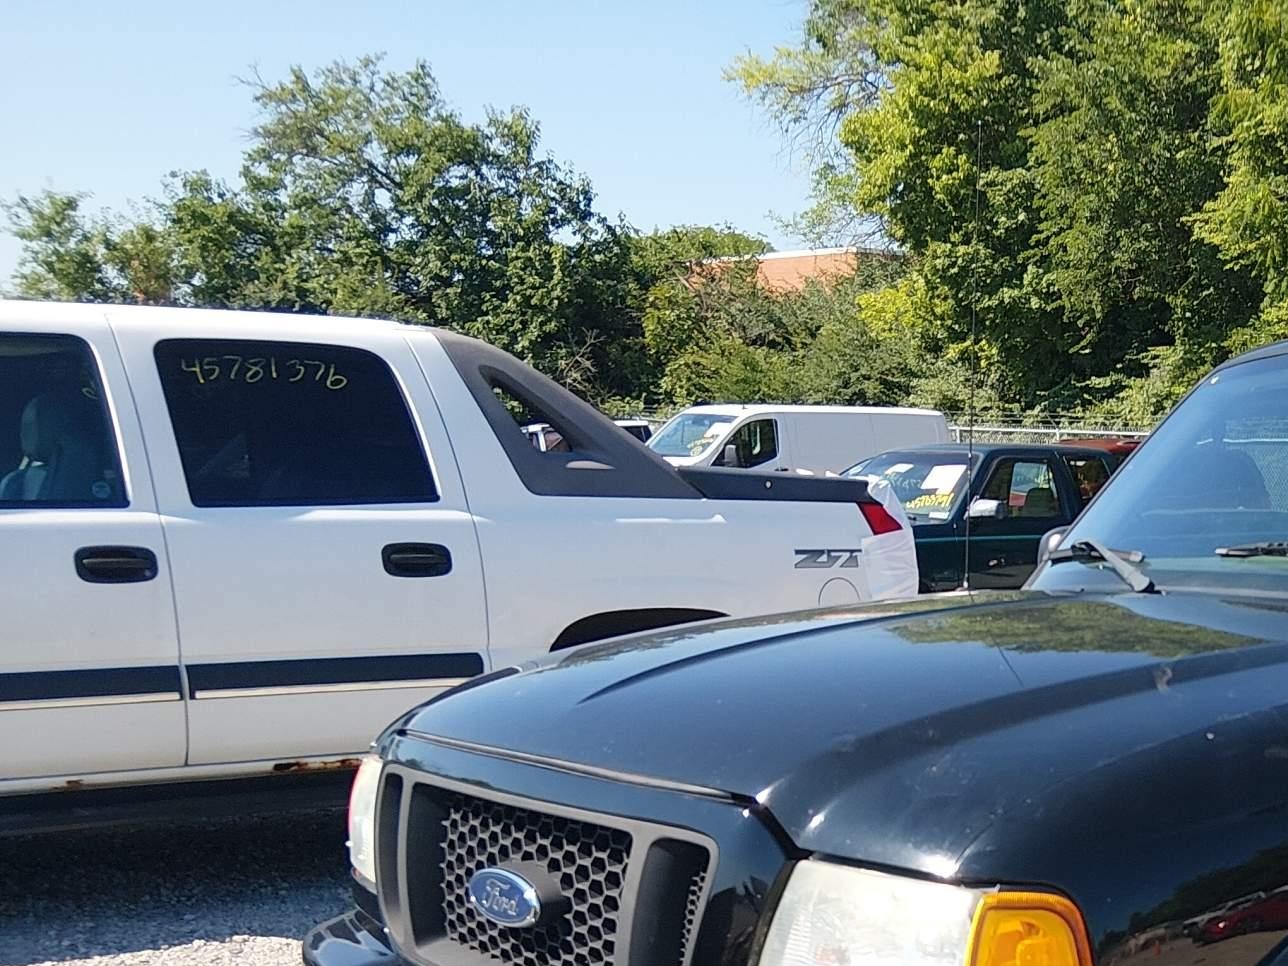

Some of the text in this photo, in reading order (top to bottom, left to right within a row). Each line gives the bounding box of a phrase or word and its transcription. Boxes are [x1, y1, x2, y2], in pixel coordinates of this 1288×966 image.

[182, 356, 348, 389] 45781376
[794, 549, 862, 568] Z71
[481, 878, 520, 916] Ford
